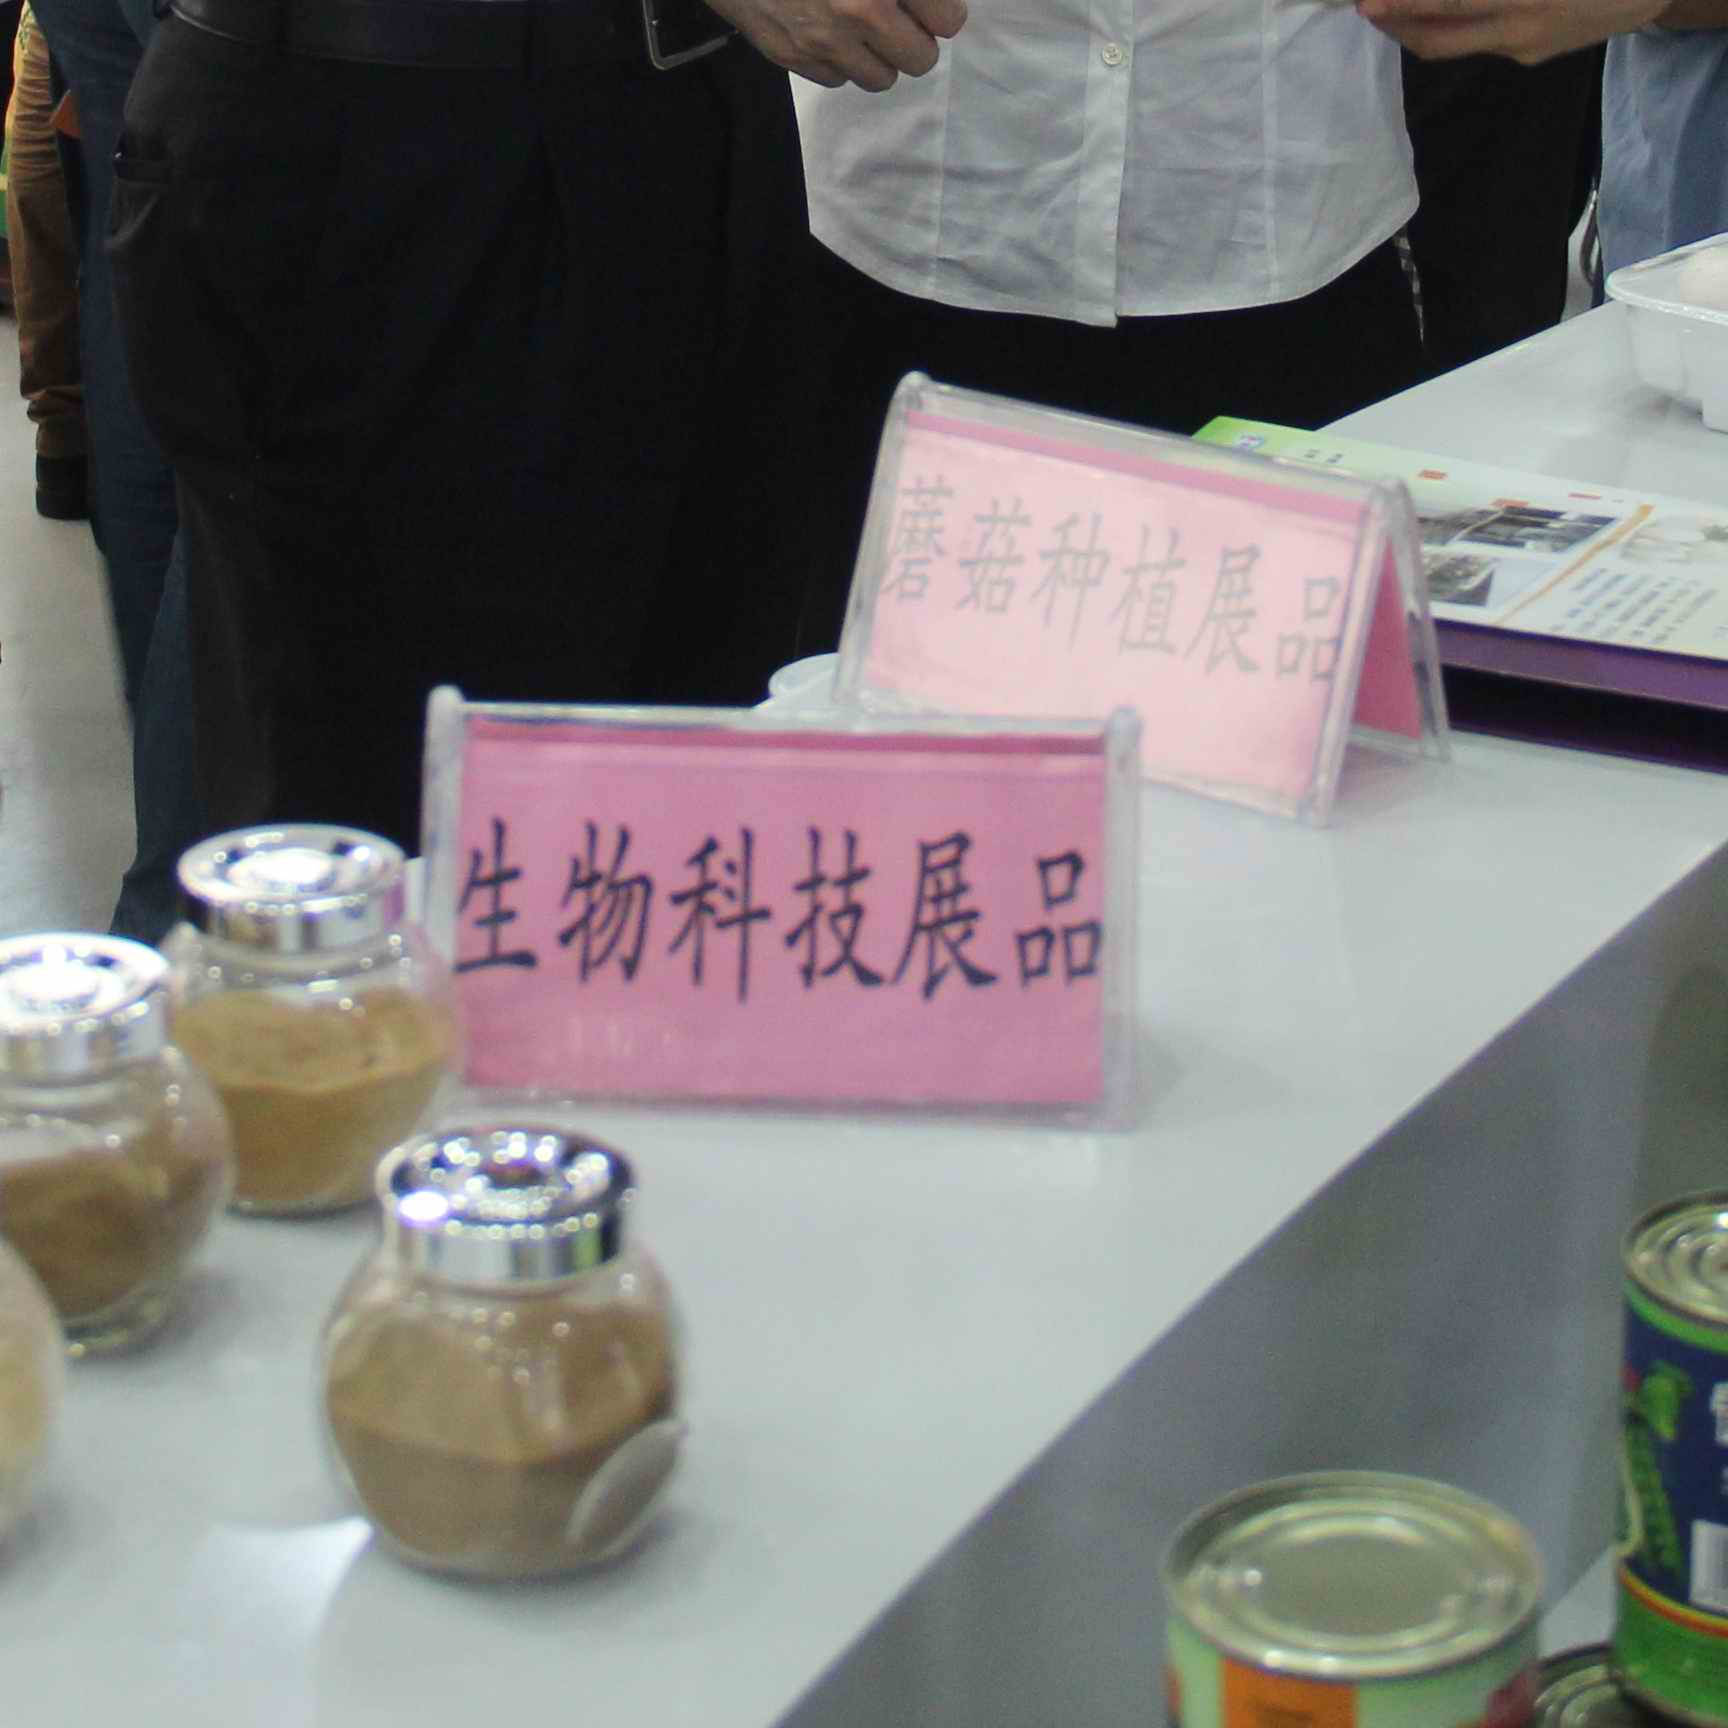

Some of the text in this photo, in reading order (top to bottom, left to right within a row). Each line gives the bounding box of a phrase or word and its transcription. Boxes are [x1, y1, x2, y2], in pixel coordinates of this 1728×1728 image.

[876, 474, 1344, 684] 蘑菇种植展品
[452, 816, 1103, 1003] 生物科技展品
